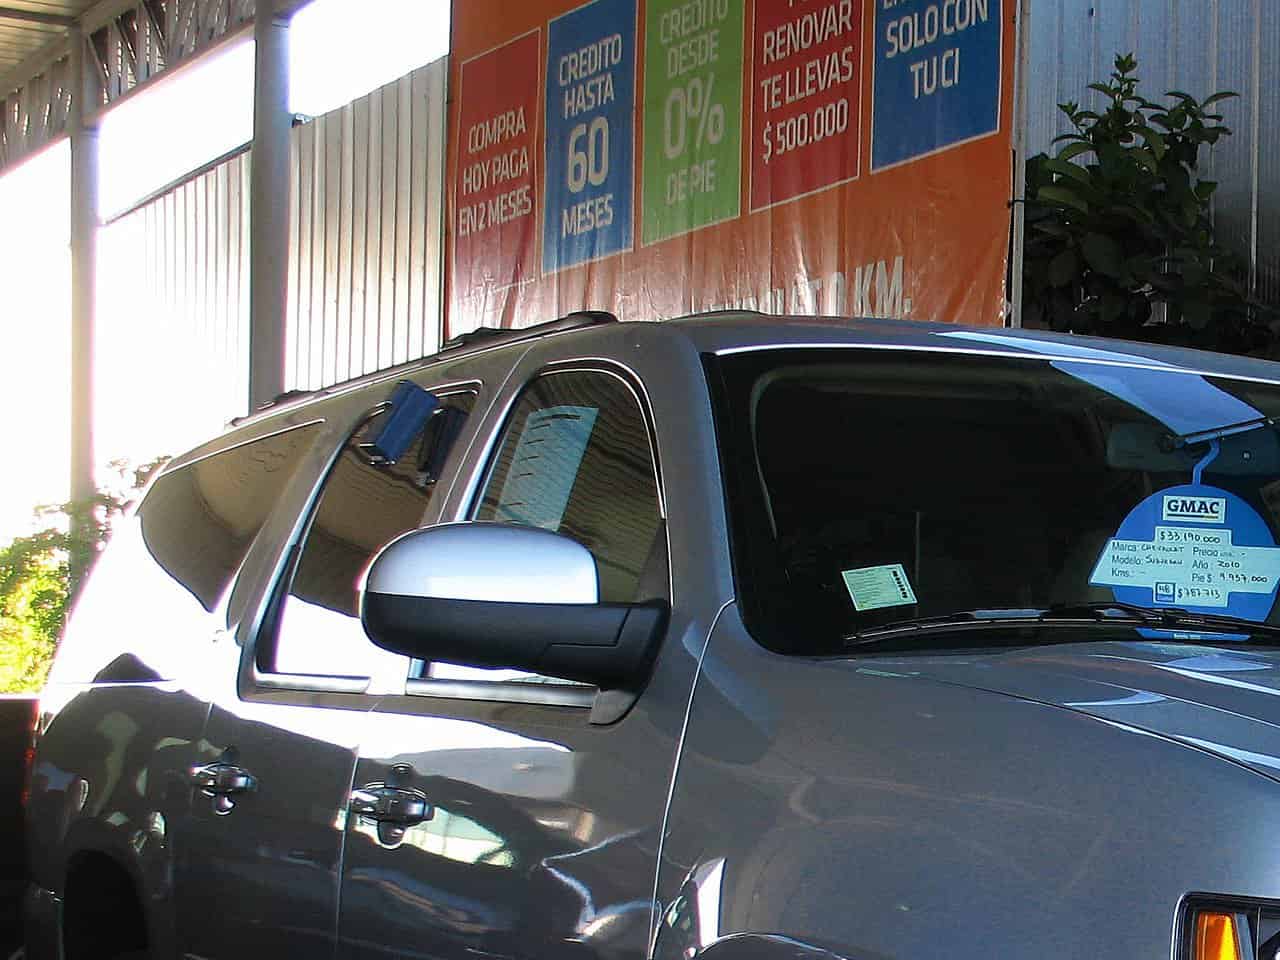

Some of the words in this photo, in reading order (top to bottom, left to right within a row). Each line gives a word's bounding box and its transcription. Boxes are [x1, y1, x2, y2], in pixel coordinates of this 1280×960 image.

[667, 29, 720, 79] DESDE
[763, 1, 852, 64] RENOVAR
[886, 5, 939, 58] SOLO
[943, 0, 988, 35] CON
[559, 33, 622, 86] CREDITO
[760, 74, 782, 112] TE
[785, 46, 853, 104] LLEVAS
[910, 56, 937, 99] TU
[941, 47, 960, 88] CI
[564, 73, 615, 120] HASTA
[664, 72, 724, 159] 0%
[469, 106, 526, 154] COMPRA
[776, 98, 848, 155] 500.000
[463, 160, 492, 196] HOY
[492, 147, 529, 185] PAGA
[568, 116, 609, 194] 60
[666, 167, 687, 206] DE
[691, 159, 716, 194] PIE
[459, 206, 477, 238] EN
[478, 203, 486, 230] 2
[487, 185, 531, 228] MESES
[562, 193, 613, 238] MESES
[1168, 499, 1220, 514] GMAC
